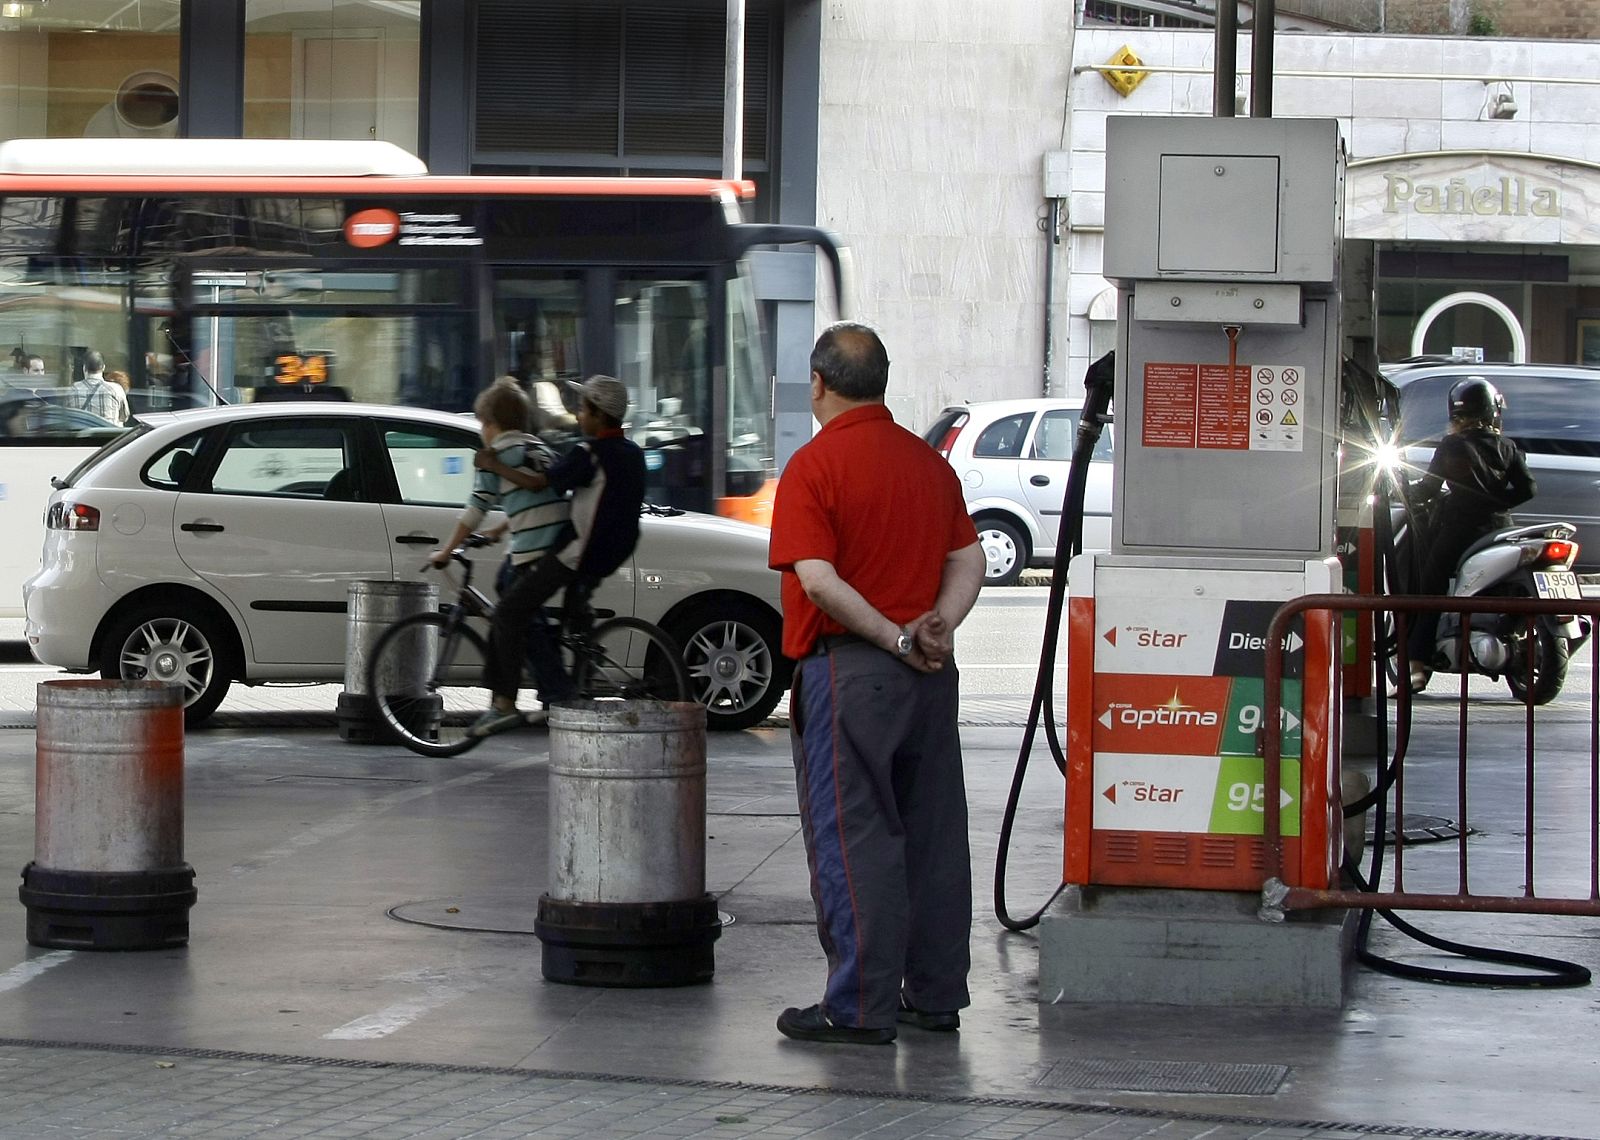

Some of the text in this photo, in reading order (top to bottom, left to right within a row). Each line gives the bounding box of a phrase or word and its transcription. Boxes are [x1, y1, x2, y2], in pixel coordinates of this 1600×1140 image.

[1382, 173, 1561, 217] Pañella
[1545, 574, 1575, 586] 1950
[1137, 630, 1188, 649] star
[1120, 707, 1218, 729] optima
[1134, 785, 1184, 803] star
